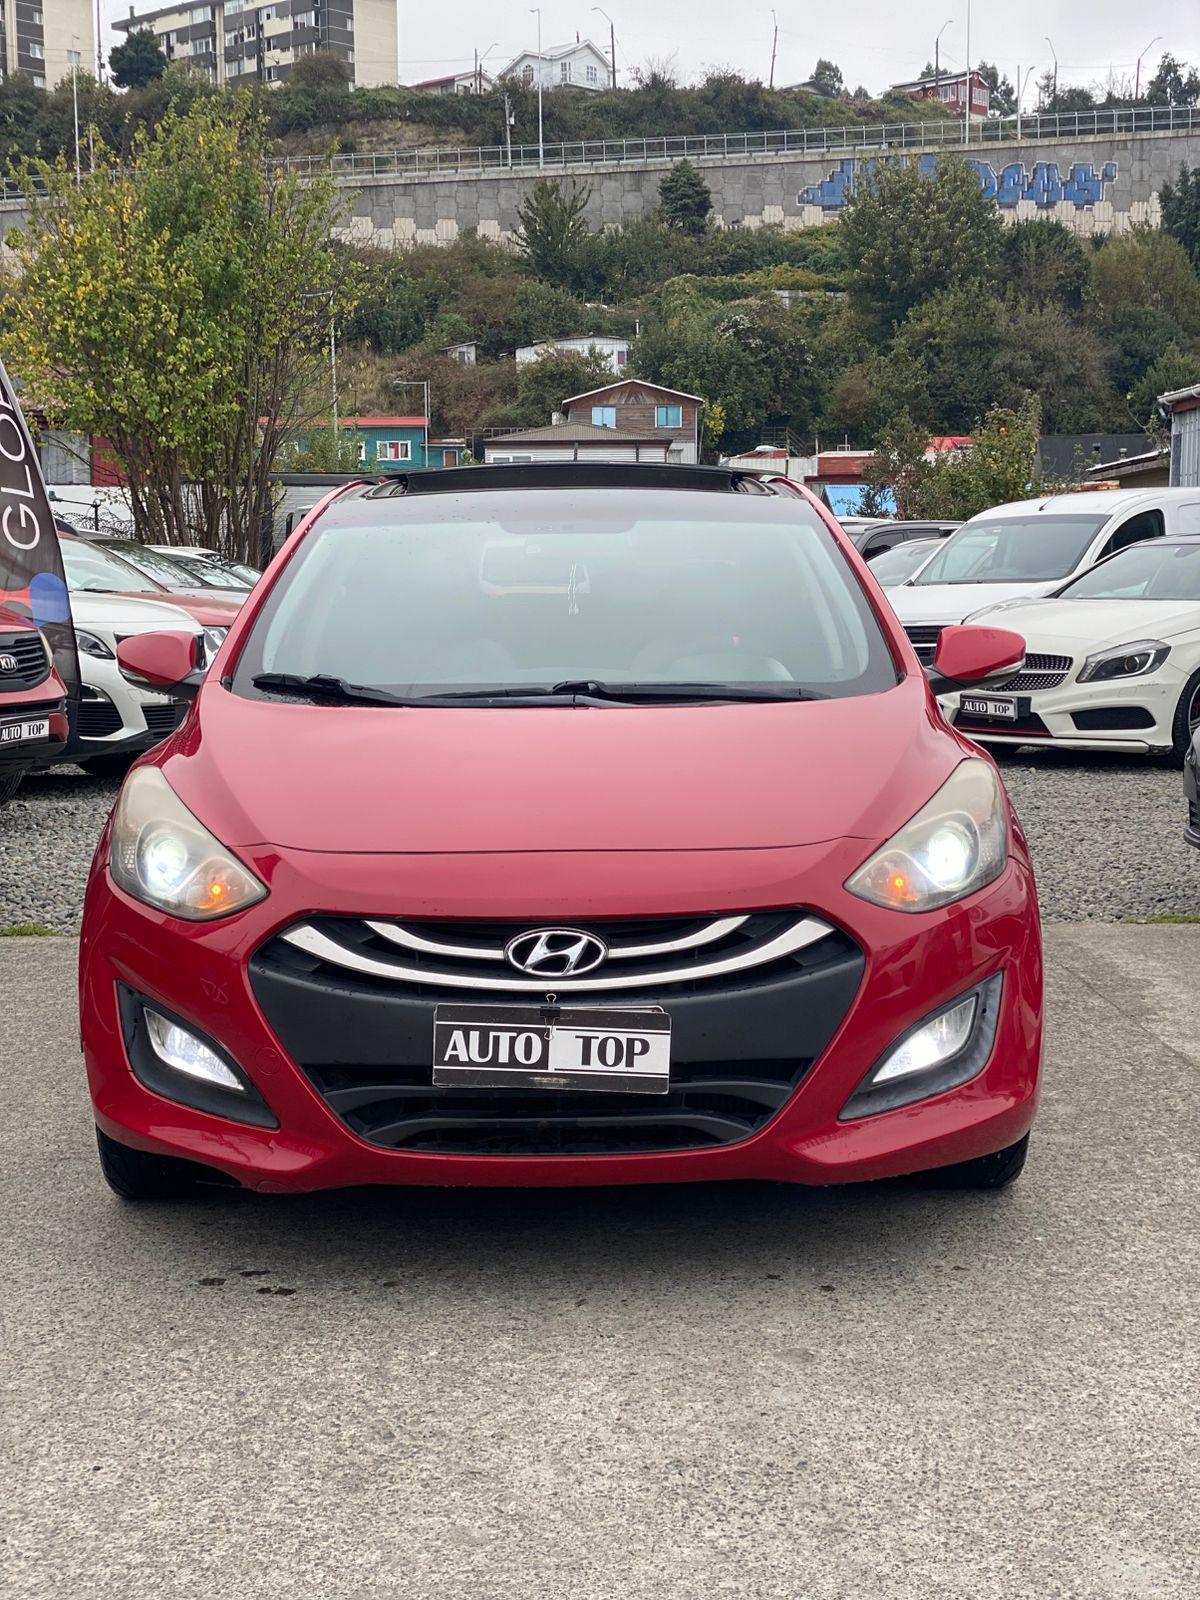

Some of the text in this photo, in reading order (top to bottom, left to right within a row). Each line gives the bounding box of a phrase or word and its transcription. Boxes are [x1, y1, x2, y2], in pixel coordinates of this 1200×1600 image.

[0, 656, 17, 670] KIA
[964, 701, 1010, 714] AUTO TOP
[1, 722, 45, 741] AUTO TOP
[443, 1030, 651, 1069] AUTO TOP
